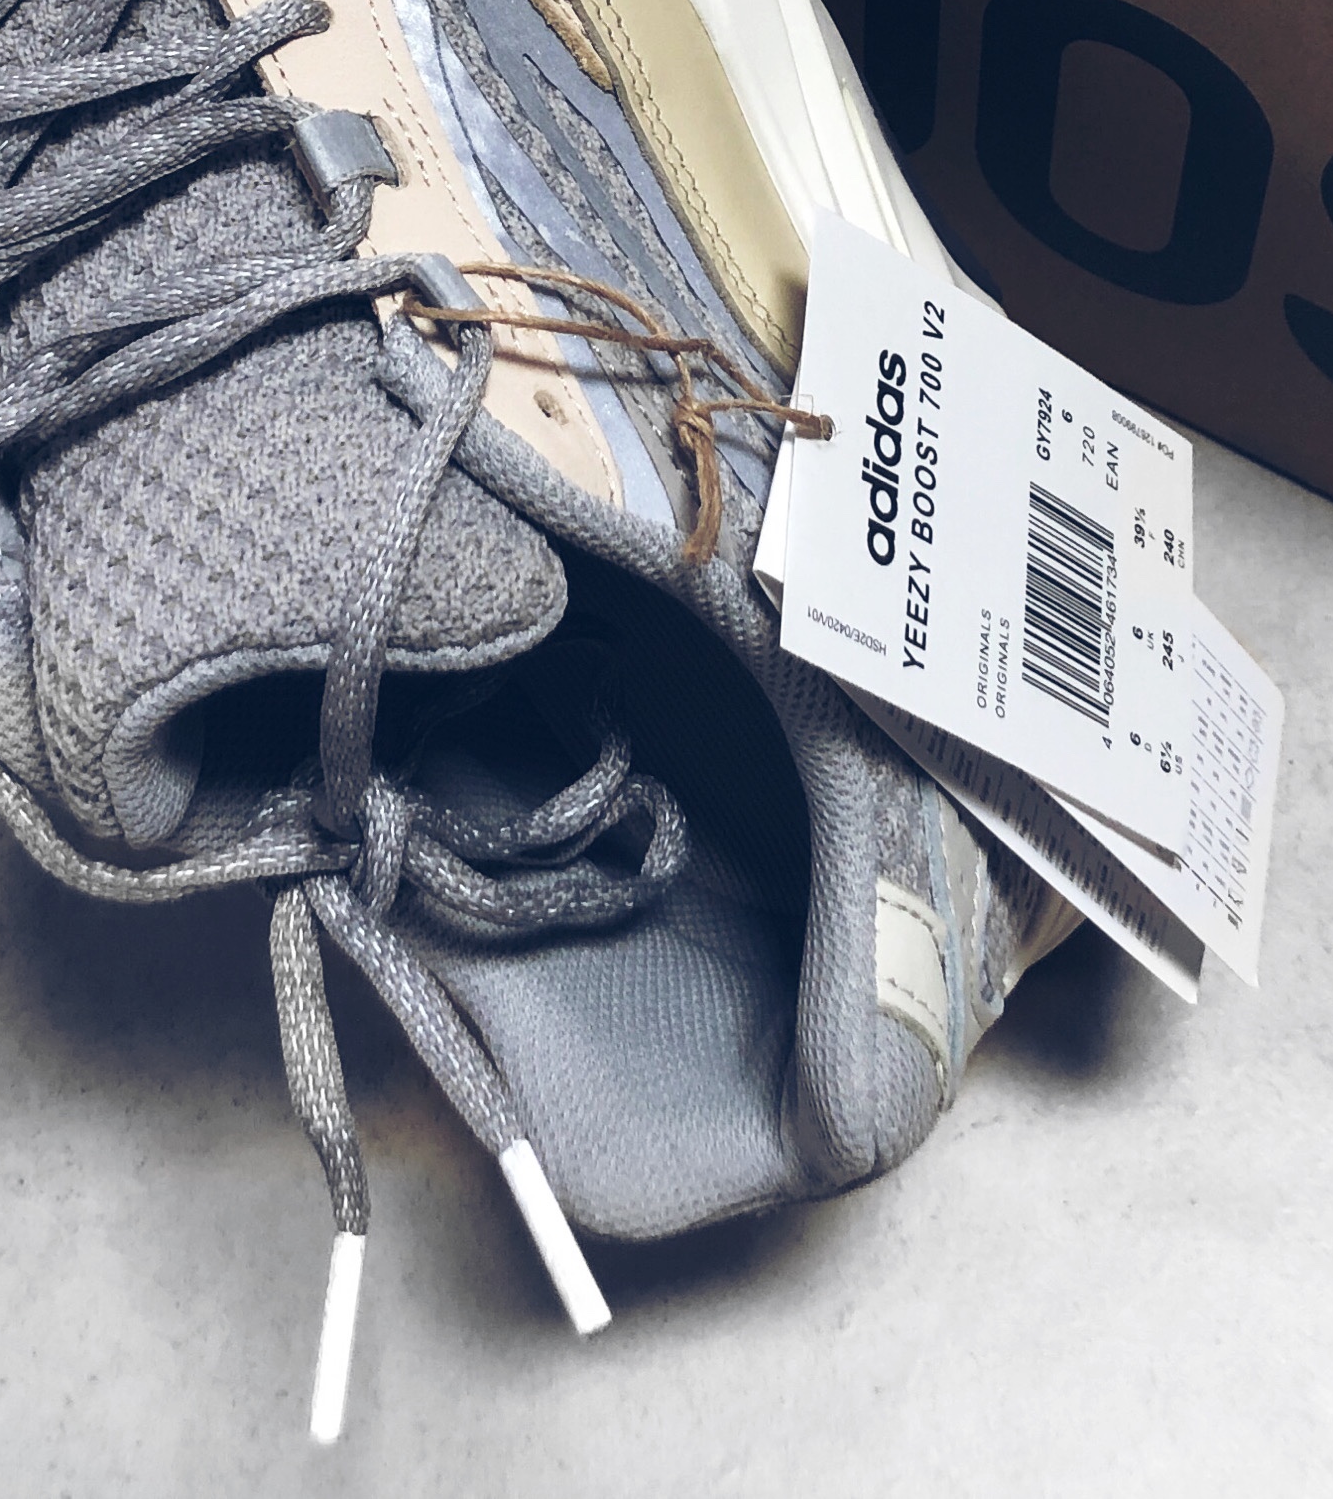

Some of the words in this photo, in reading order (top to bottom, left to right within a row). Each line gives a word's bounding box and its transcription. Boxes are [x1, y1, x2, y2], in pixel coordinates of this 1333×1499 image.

[923, 300, 946, 341] V2
[919, 352, 943, 411] 700
[1036, 387, 1053, 461] GY7924
[1061, 409, 1073, 424] 6
[861, 349, 907, 566] adidas
[1082, 425, 1095, 467] 720
[1106, 441, 1119, 491] EAN
[911, 417, 939, 545] BOOST
[1163, 528, 1175, 566] 240
[902, 550, 931, 670] YEEZY
[1132, 626, 1143, 640] 6
[1147, 631, 1154, 650] UK
[1162, 629, 1174, 672] 245
[976, 608, 992, 709] ORIGINALS
[995, 617, 1010, 719] ORIGINALS
[1102, 735, 1113, 750] 4
[1129, 731, 1141, 746] 6
